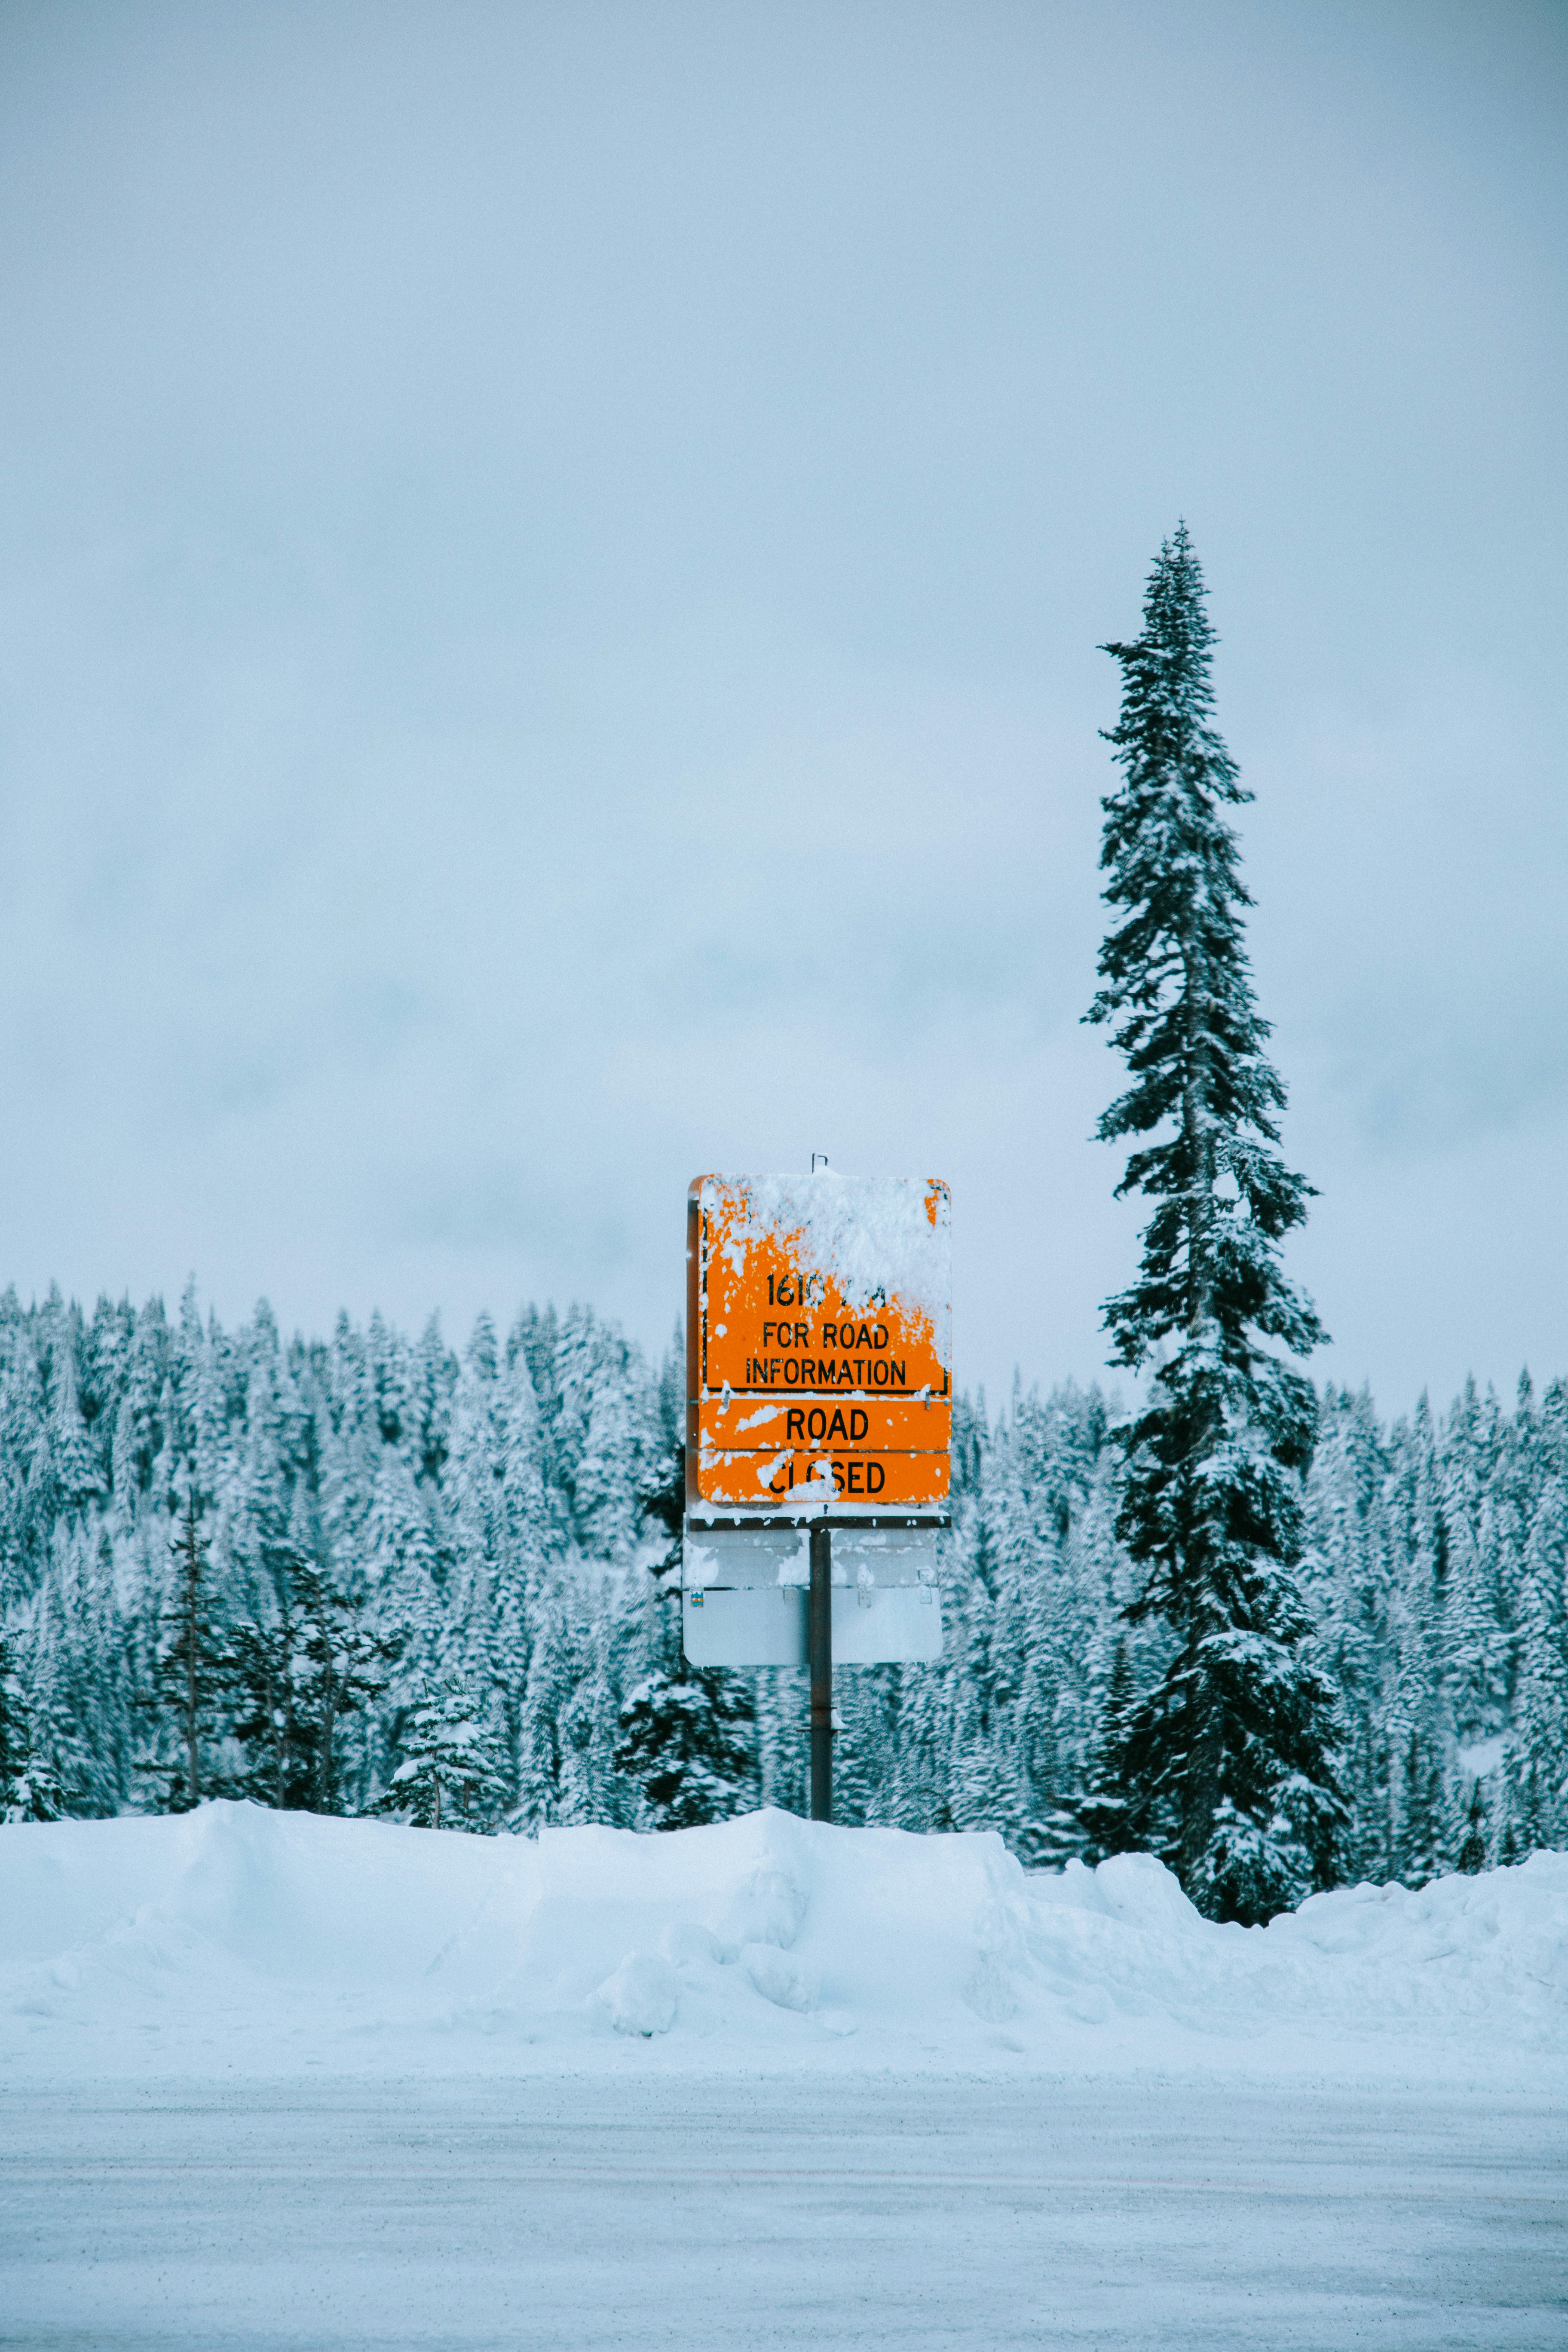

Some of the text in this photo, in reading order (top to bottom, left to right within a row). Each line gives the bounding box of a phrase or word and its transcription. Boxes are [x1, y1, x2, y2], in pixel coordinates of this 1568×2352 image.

[766, 1274, 824, 1306] 1610
[763, 1322, 889, 1349] FOR ROAD
[746, 1358, 906, 1386] INFORMATION
[787, 1408, 869, 1440] ROAD
